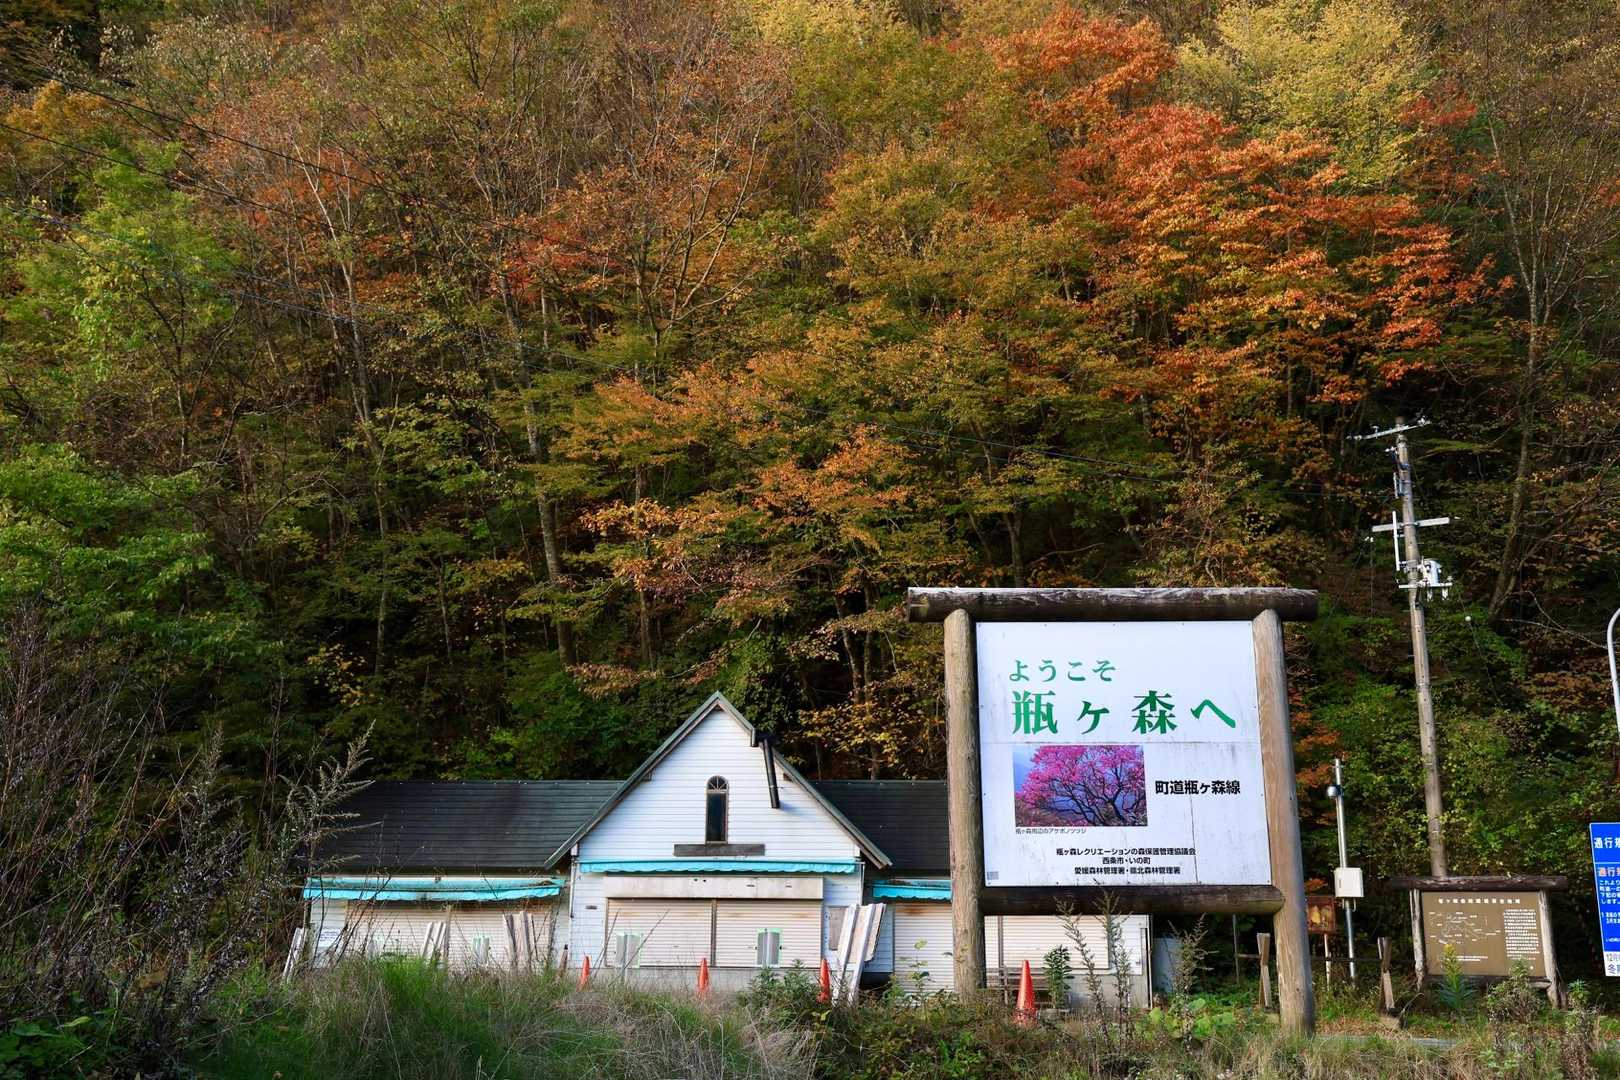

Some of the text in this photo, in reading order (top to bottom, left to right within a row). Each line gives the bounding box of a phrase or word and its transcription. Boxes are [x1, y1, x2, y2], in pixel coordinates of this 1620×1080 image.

[1009, 659, 1116, 682] ようこそ
[1011, 690, 1236, 735] 瓶ヶ森へ
